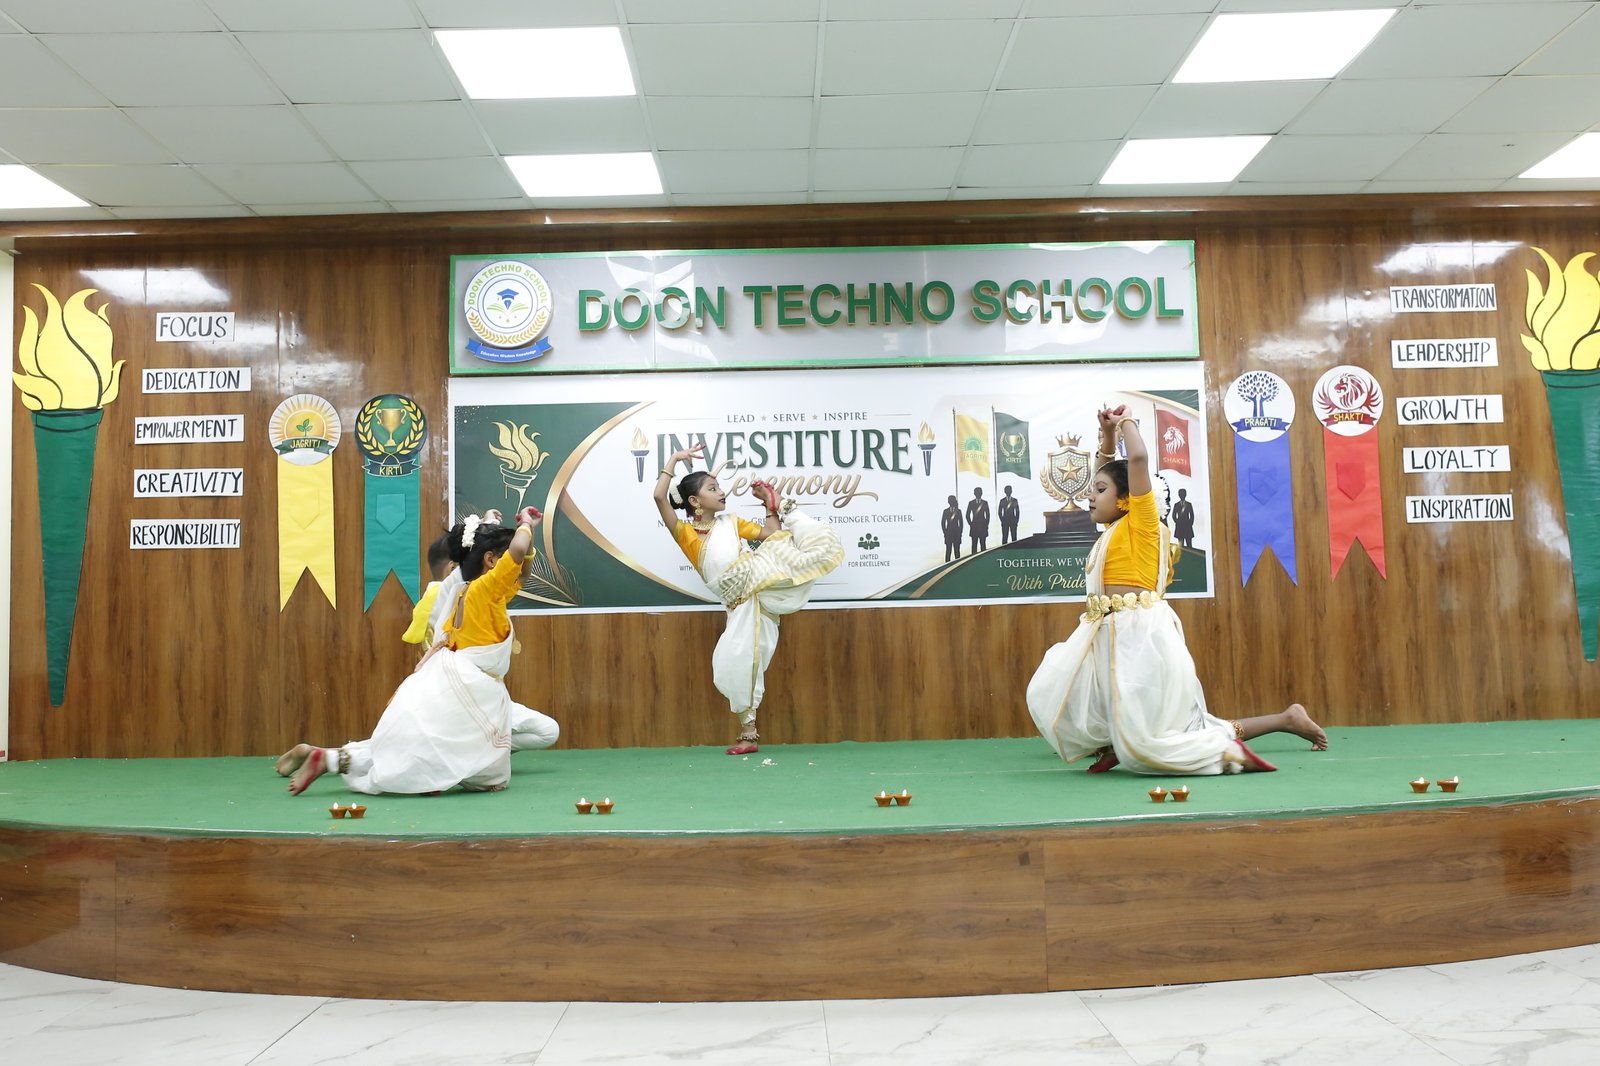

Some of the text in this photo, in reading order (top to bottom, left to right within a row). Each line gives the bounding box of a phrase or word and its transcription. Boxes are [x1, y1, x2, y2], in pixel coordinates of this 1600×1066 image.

[468, 264, 548, 305] DOON TECHNO SCHOOL
[577, 276, 1185, 332] DOON TECHNO SCHOOL
[1391, 286, 1496, 309] TRANSFORMATION
[159, 315, 228, 338] FOCUS
[1397, 342, 1490, 363] LEADERSHIP
[145, 370, 241, 391] DEDICATION
[727, 412, 868, 423] LEAD SERVE INSPIRE
[1333, 412, 1364, 422] SHAKTI
[1401, 398, 1488, 421] GROWTH
[136, 418, 238, 439] EMPOWERMENT
[1244, 418, 1277, 427] PRAGATI
[290, 439, 321, 449] JAGRITI
[1162, 456, 1187, 465] SHAKTI
[1411, 448, 1498, 470] LOYALTY
[379, 466, 403, 476] KIRTI
[136, 471, 243, 494] CREATIVITY
[1411, 497, 1511, 519] INSPIRATION
[828, 515, 870, 523] STRONGER
[132, 522, 241, 546] RESPONSIBILITY
[996, 558, 1054, 568] TOGETHER,
[1056, 557, 1073, 566] WE
[1006, 573, 1086, 591] With Pride
